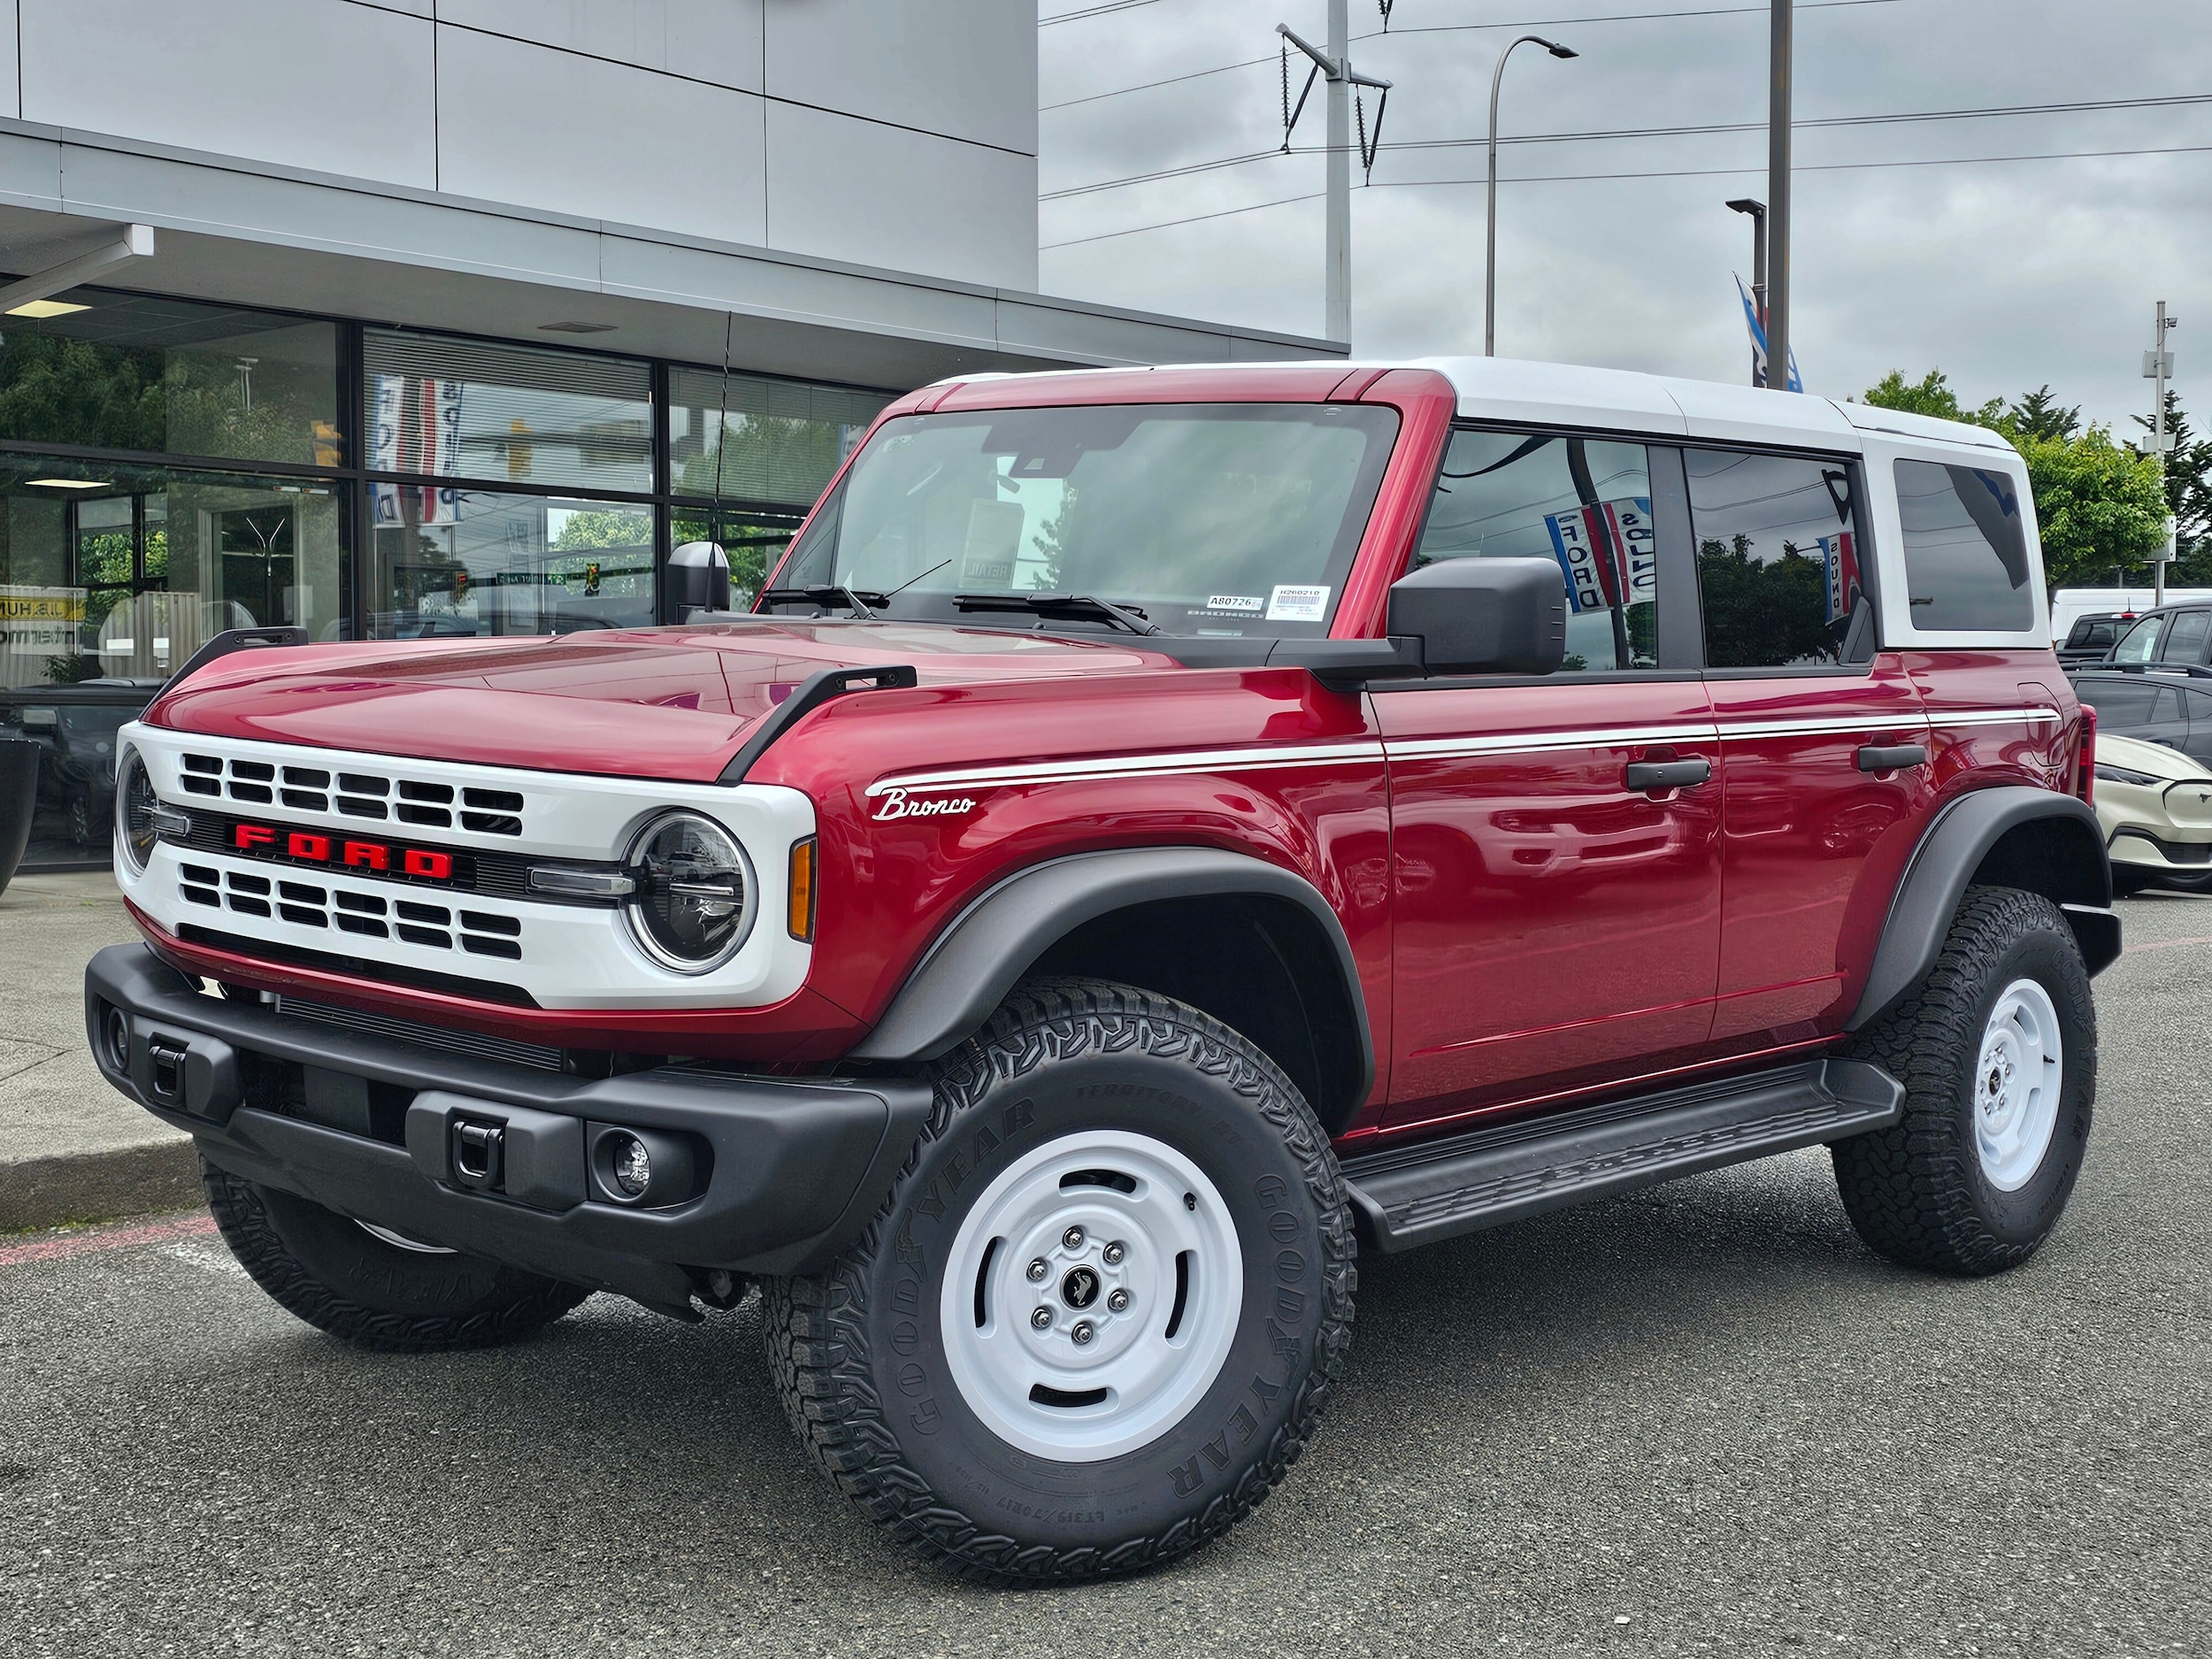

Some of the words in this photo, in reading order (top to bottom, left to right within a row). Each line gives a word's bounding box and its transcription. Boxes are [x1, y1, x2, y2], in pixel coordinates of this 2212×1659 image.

[1210, 597, 1251, 607] A80726
[872, 787, 976, 821] Bronco
[236, 824, 453, 879] FORD
